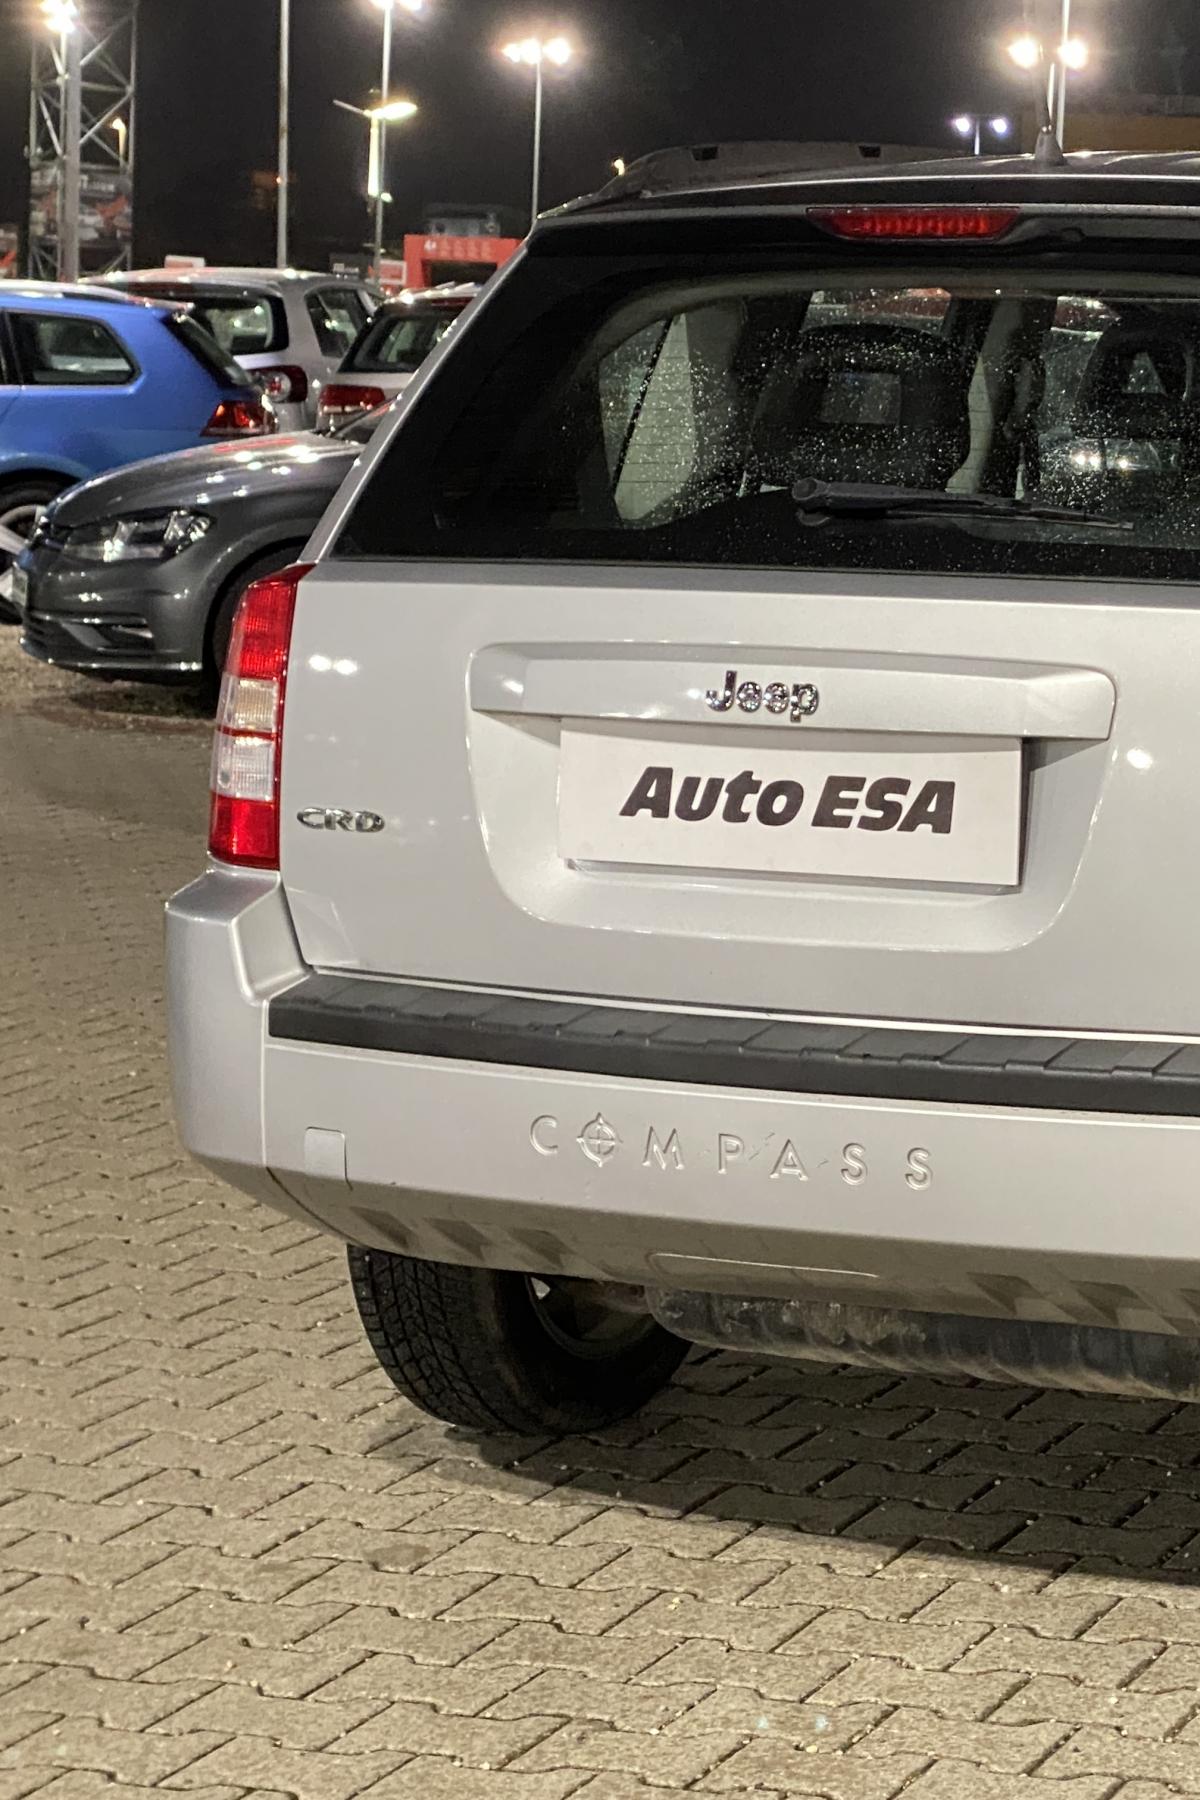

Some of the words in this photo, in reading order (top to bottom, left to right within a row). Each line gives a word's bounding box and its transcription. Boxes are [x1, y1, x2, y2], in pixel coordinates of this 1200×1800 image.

[705, 670, 820, 723] Jeep
[296, 807, 385, 833] CRD
[619, 766, 805, 826] Auto
[811, 775, 956, 834] ESA
[529, 1112, 934, 1190] COMPASS
